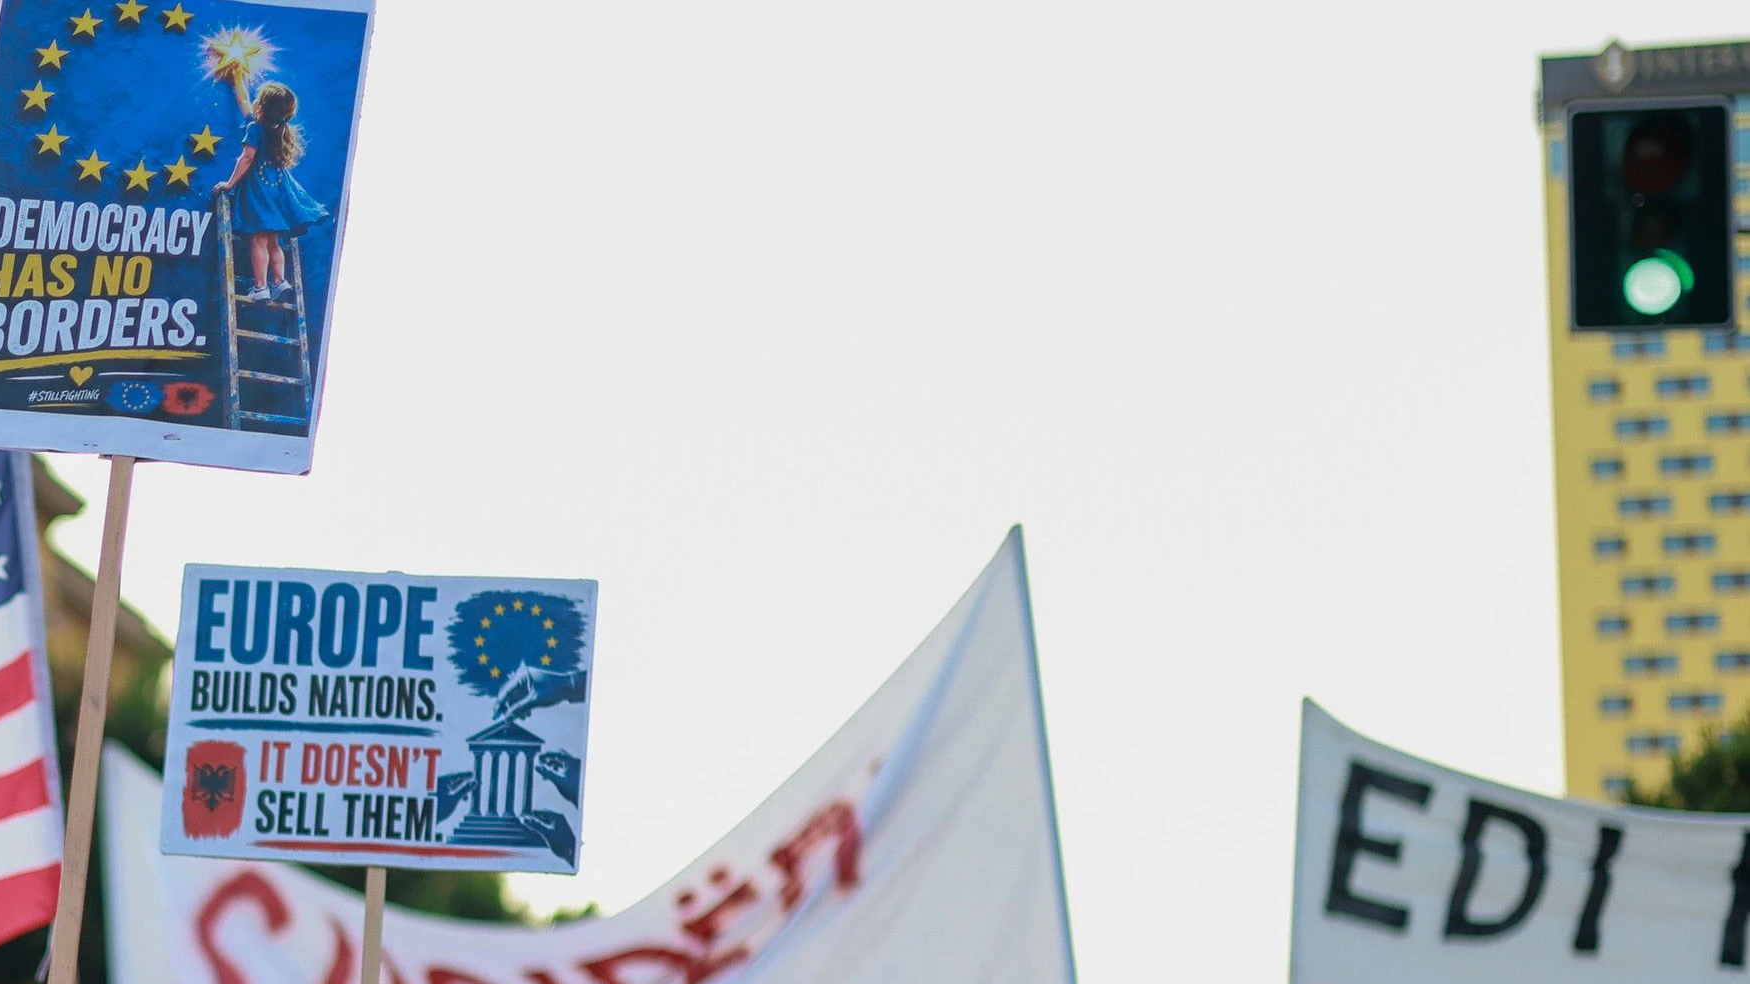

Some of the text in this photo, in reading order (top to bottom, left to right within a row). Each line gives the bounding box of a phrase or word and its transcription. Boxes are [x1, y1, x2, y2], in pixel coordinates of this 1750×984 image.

[91, 255, 152, 297] NO
[28, 389, 100, 402] #STILLFIGHTING
[193, 578, 439, 671] EUROPE
[190, 670, 444, 722] BUILDS NATIONS.
[259, 740, 443, 792] IT DOESN'T
[255, 789, 444, 842] SELL THEM.
[1323, 761, 1627, 955] EDI
